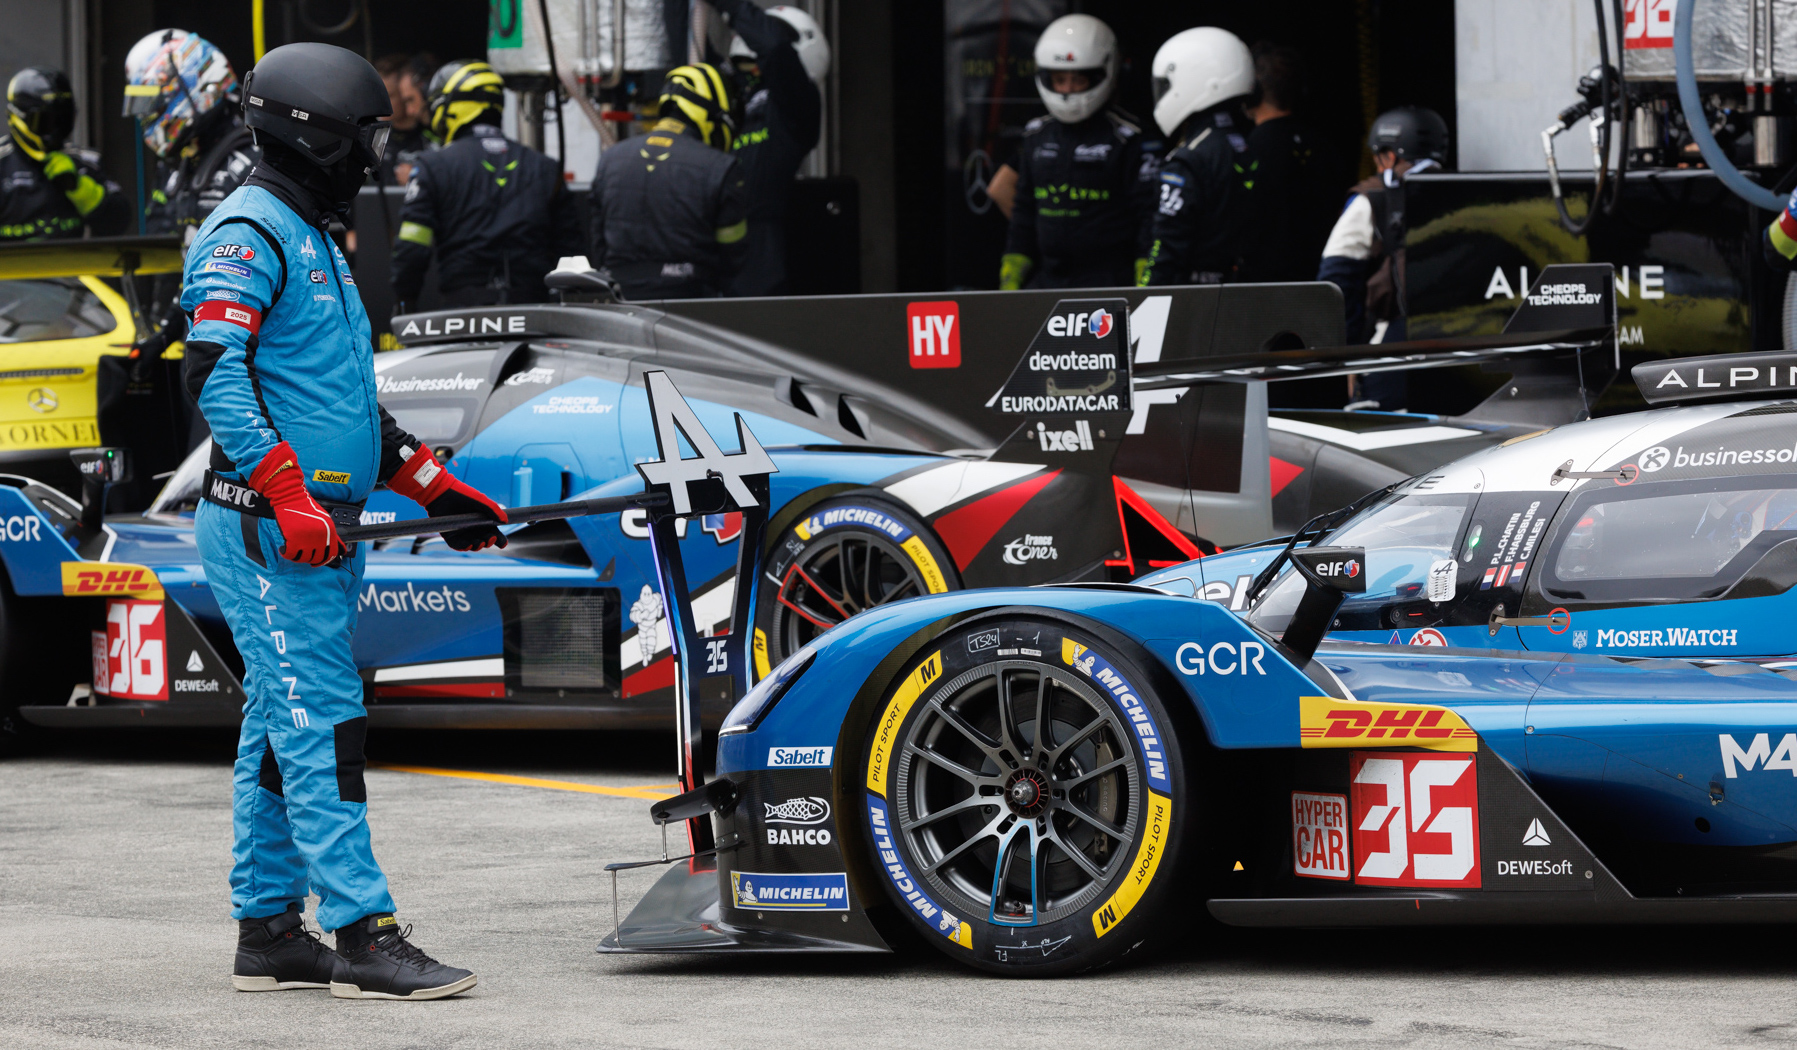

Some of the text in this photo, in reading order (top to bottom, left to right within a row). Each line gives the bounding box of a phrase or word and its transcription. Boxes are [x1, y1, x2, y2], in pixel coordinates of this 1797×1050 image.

[213, 244, 240, 258] elf
[216, 264, 248, 275] MICHELIN
[1527, 294, 1602, 306] TECHNOLOGY
[1540, 284, 1587, 295] CHEOPS
[230, 311, 248, 321] 2025
[401, 316, 526, 337] ALPINE
[1047, 313, 1089, 337] elf
[912, 315, 955, 356] HY
[1029, 350, 1116, 371] devoteam
[382, 372, 485, 393] businessolver
[533, 405, 613, 414] TECHNOLOGY
[549, 396, 600, 405] CHEOPS
[1002, 395, 1119, 413] EURODATACAR
[1036, 420, 1094, 451] ixell
[80, 461, 95, 474] elf
[317, 471, 347, 484] Sabelt
[210, 478, 259, 508] MRTC
[824, 509, 904, 538] MICHELIN
[1520, 518, 1546, 560] C.MILESI
[75, 570, 151, 592] DHL
[911, 545, 942, 593] PILOT SPOR
[1315, 561, 1344, 577] elf
[107, 603, 165, 695] 36
[256, 574, 310, 729] ALPINE
[706, 640, 727, 673] 35
[1175, 641, 1267, 676] GCR
[920, 658, 937, 684] M
[174, 679, 220, 692] DEWESoft
[1095, 667, 1166, 780] MICHELIN
[1324, 710, 1454, 738] DHL
[872, 703, 901, 782] PILOT SPORT
[774, 749, 825, 765] Sabelt
[1295, 798, 1343, 828] HYPER
[1353, 758, 1475, 880] 35
[767, 829, 831, 845] BAHCO
[1135, 805, 1163, 885] PILOT SPORT
[1297, 827, 1345, 871] CAR
[871, 807, 938, 918] MICHELIN
[1497, 860, 1573, 876] DEWESoft
[759, 887, 844, 900] MICHELIN
[1098, 904, 1117, 930] M
